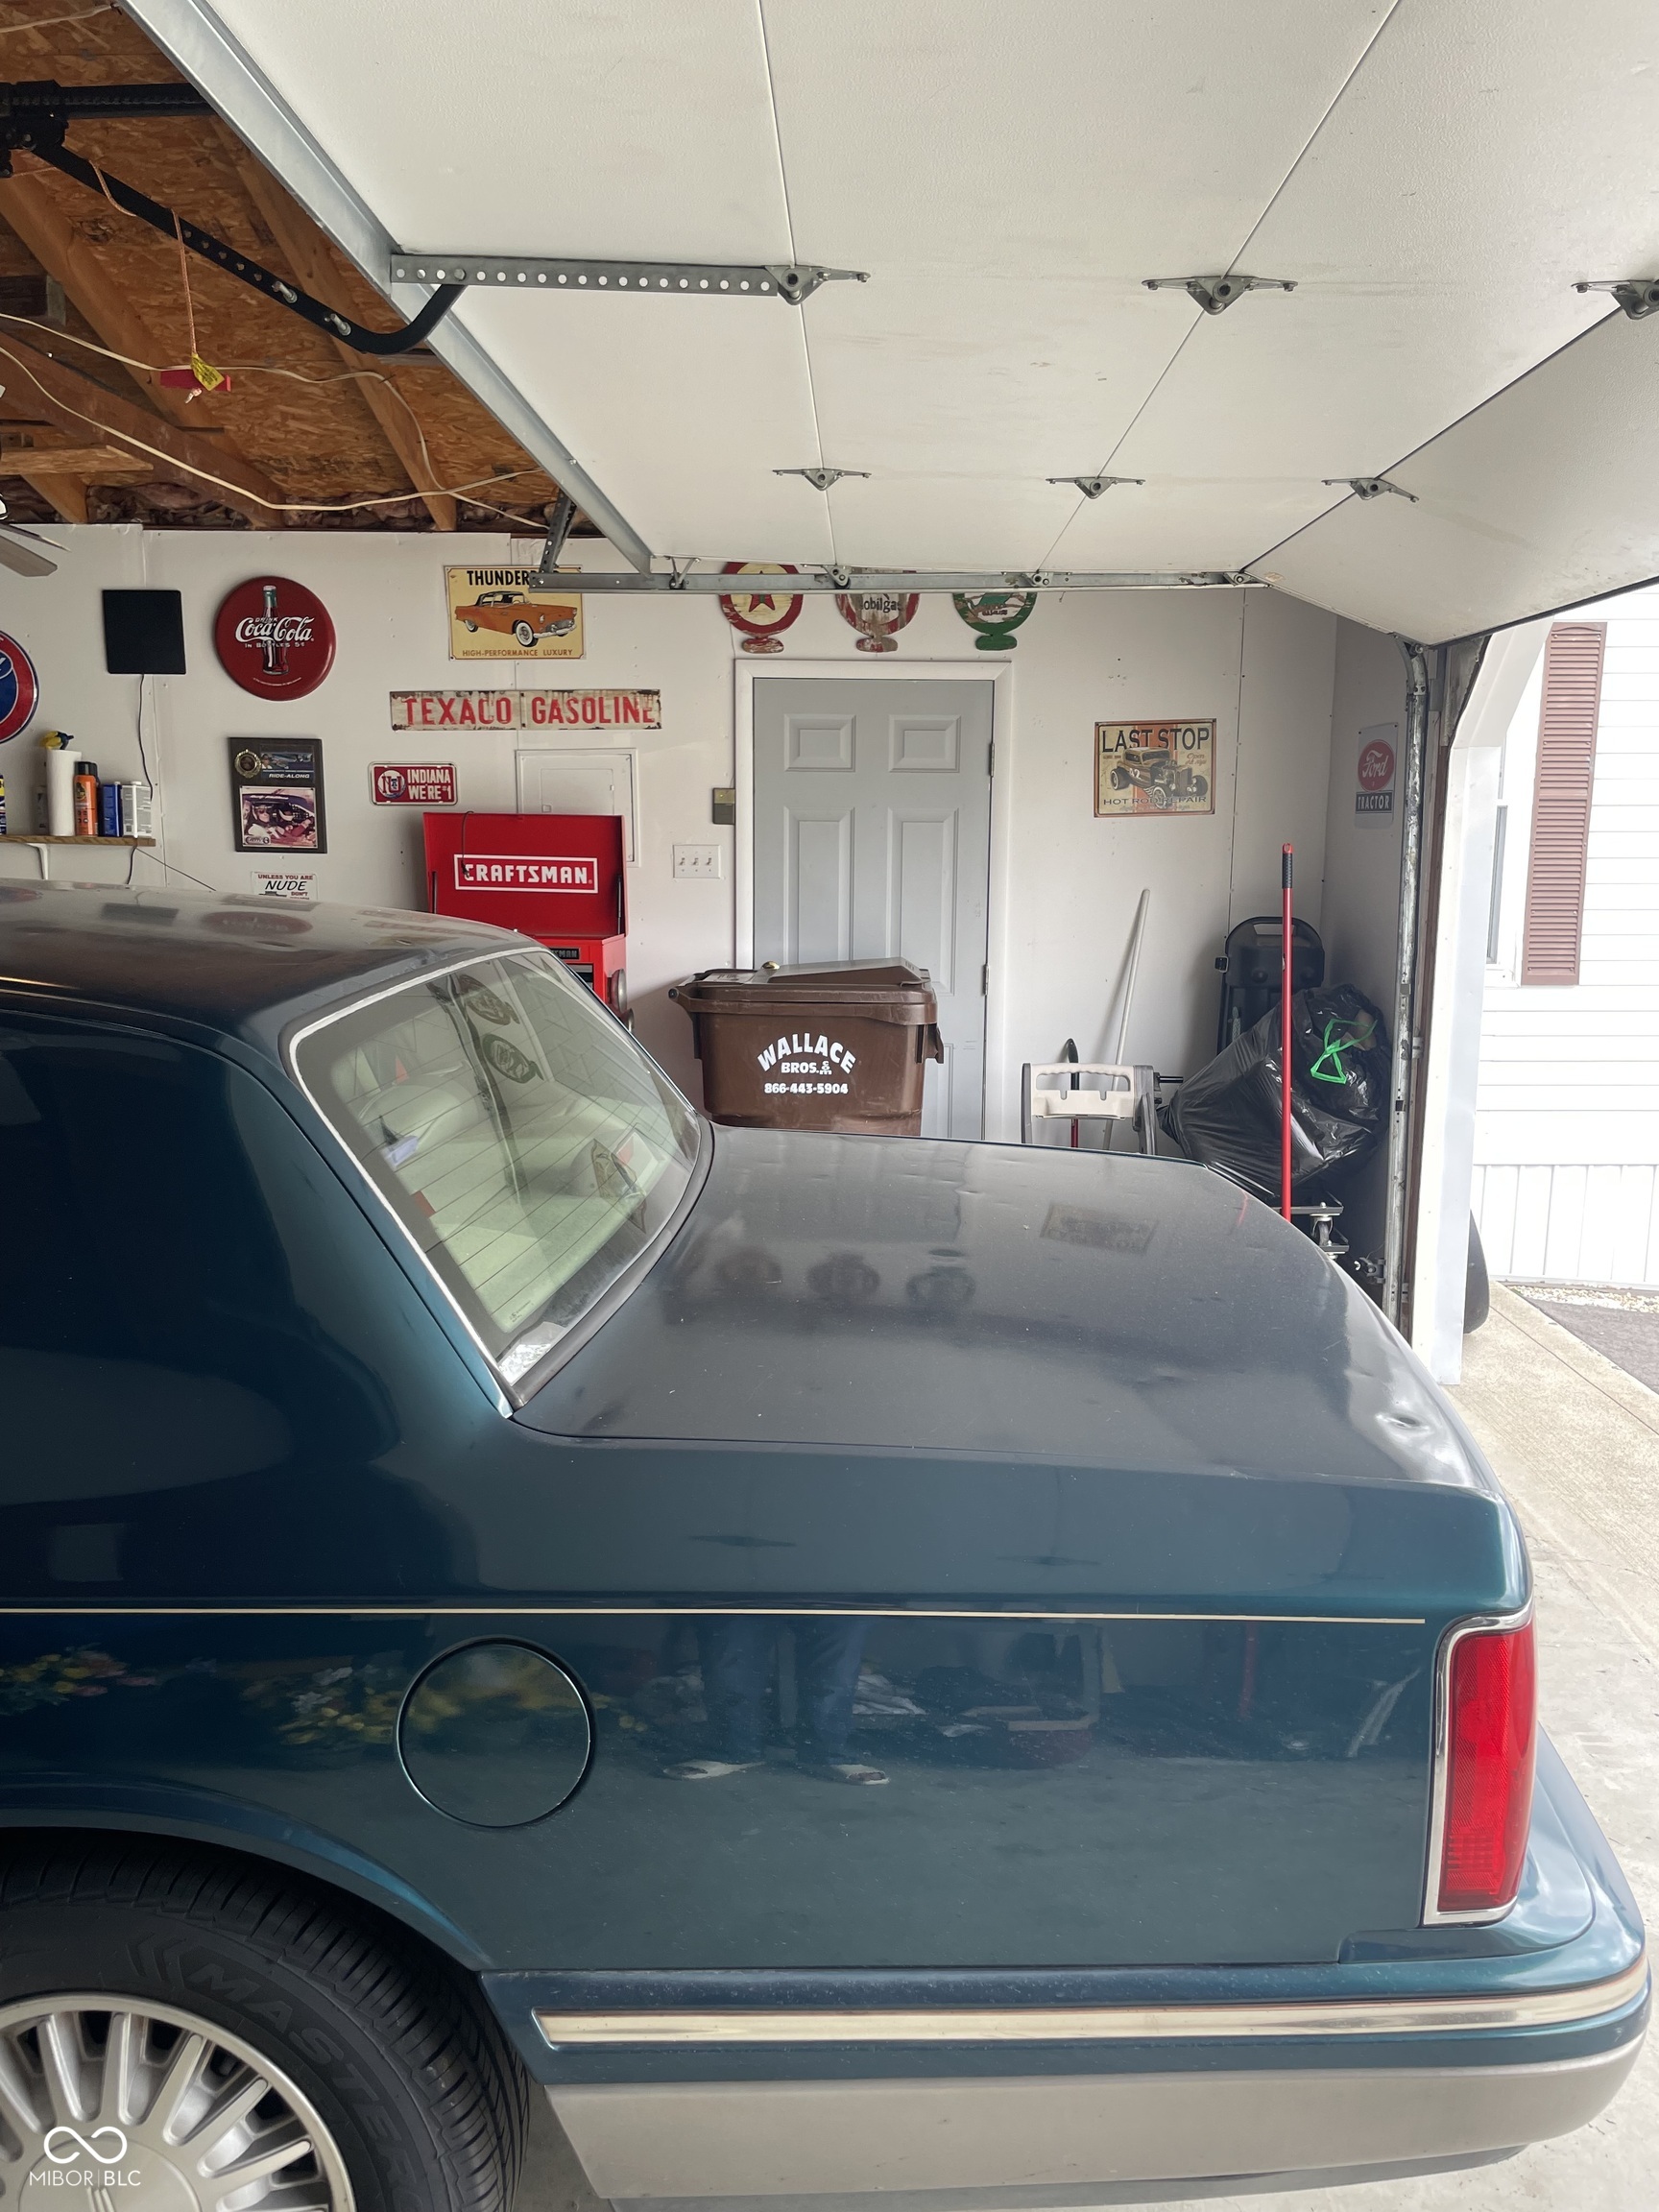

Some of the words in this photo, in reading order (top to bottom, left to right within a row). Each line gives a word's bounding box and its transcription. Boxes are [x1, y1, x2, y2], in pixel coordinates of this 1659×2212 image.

[467, 570, 537, 586] THUNDER
[403, 697, 513, 726] TEXACO
[531, 696, 656, 725] GASOLINE
[1102, 729, 1153, 753] LAST
[1158, 728, 1210, 750] STOP
[1362, 750, 1389, 778] Ford
[407, 769, 451, 783] INDIANA
[1358, 795, 1389, 809] TRACTOR
[462, 863, 588, 884] CRAFTSMAN
[265, 880, 307, 891] NUDE
[757, 1032, 856, 1074] WALLACE
[764, 1083, 849, 1094] 866-443-5904
